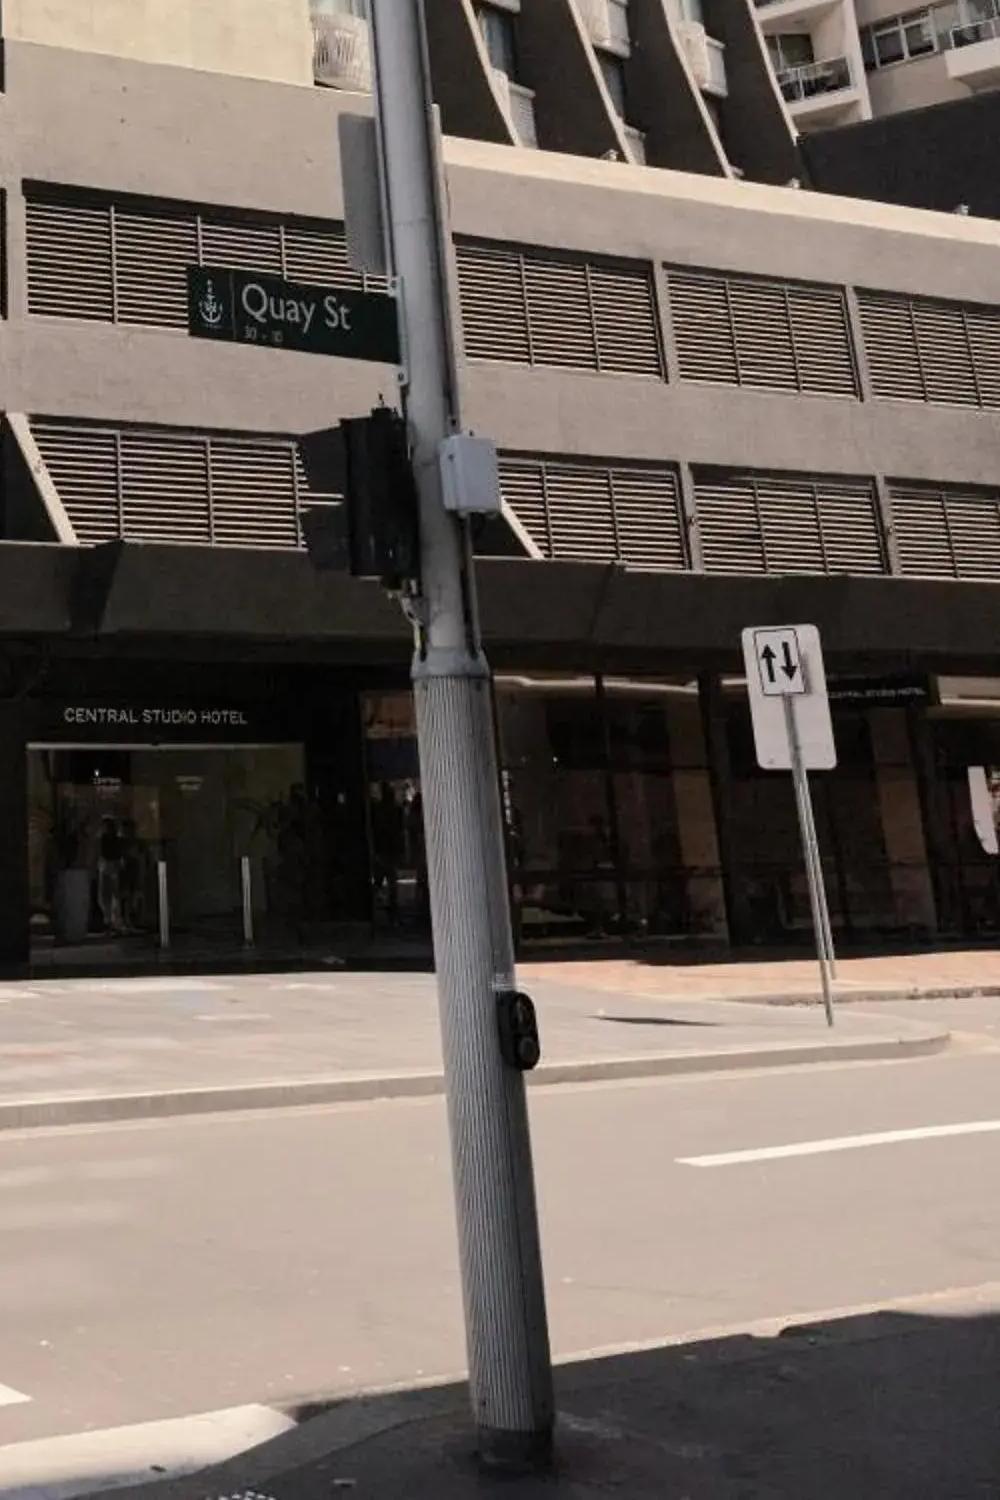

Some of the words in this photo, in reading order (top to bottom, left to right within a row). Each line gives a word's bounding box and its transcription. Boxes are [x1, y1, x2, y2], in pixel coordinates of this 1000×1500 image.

[241, 283, 315, 333] Quay
[324, 295, 352, 330] St
[64, 707, 139, 723] CENTRAL
[143, 709, 196, 724] STUDIO
[200, 710, 248, 725] HOTEL
